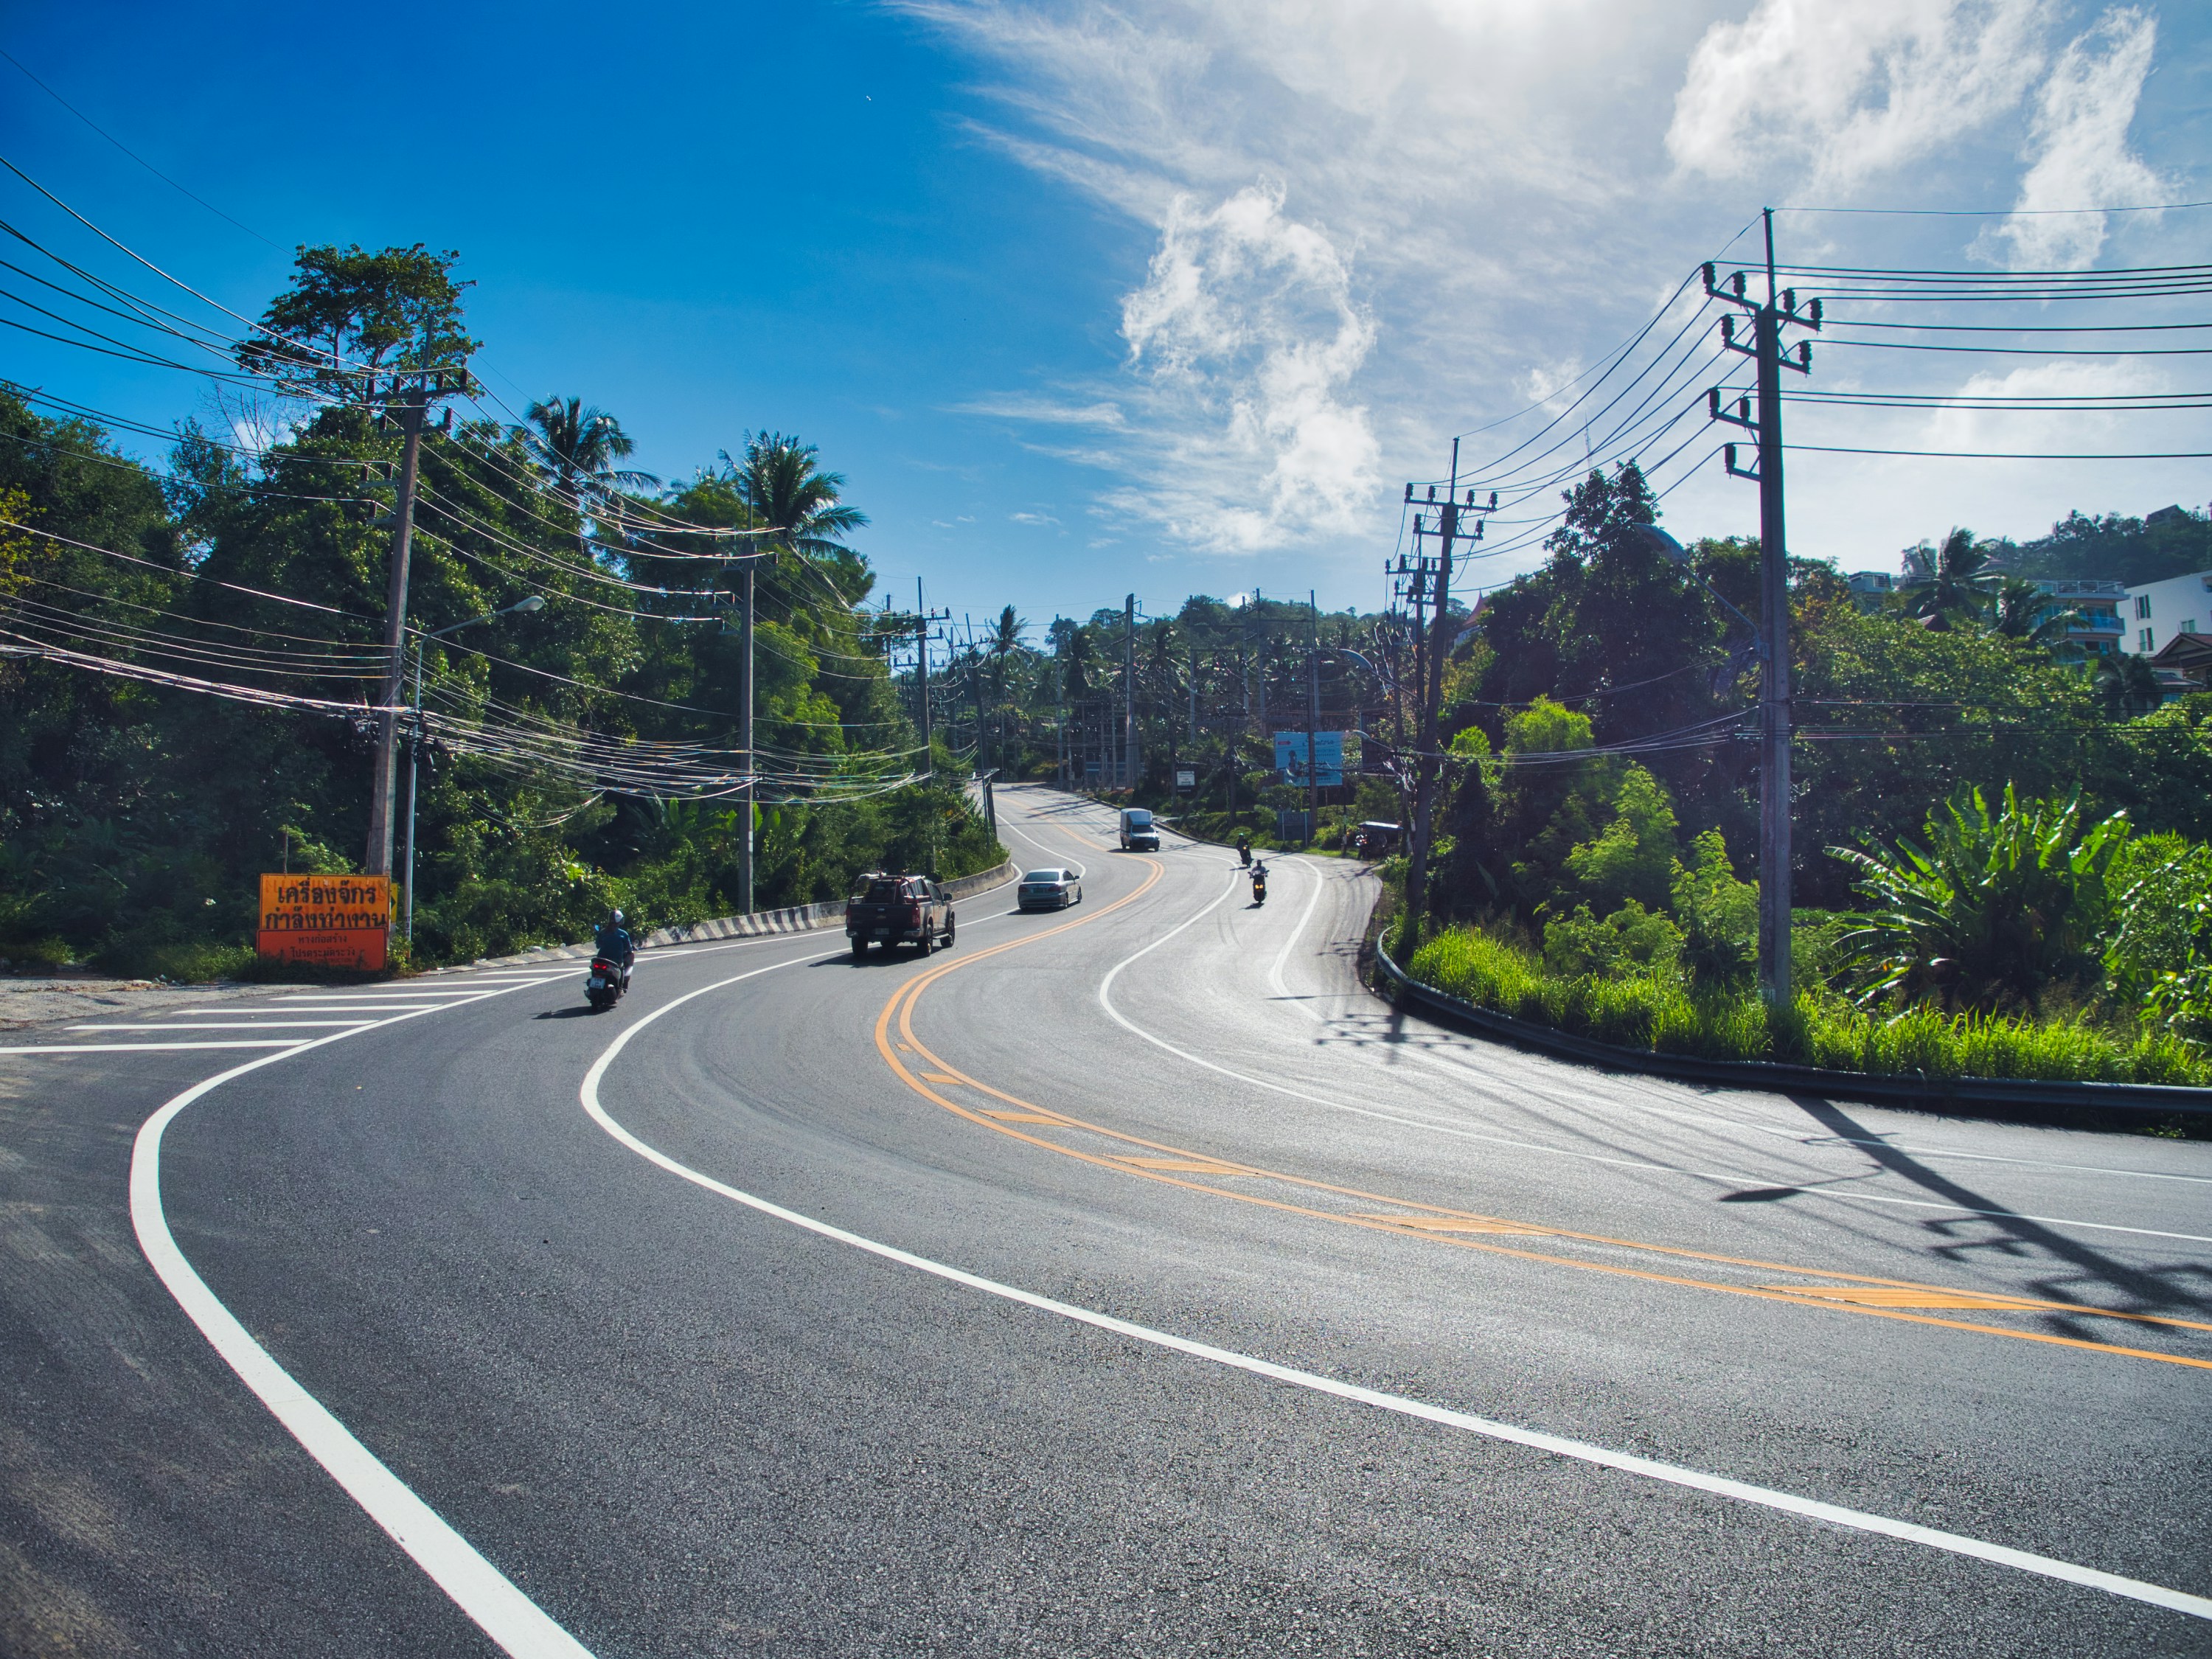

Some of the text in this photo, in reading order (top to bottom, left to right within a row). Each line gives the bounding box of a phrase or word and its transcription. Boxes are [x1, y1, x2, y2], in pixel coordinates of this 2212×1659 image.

[278, 877, 376, 904] เครื่องจักร
[265, 905, 388, 929] กำลังทำงาน
